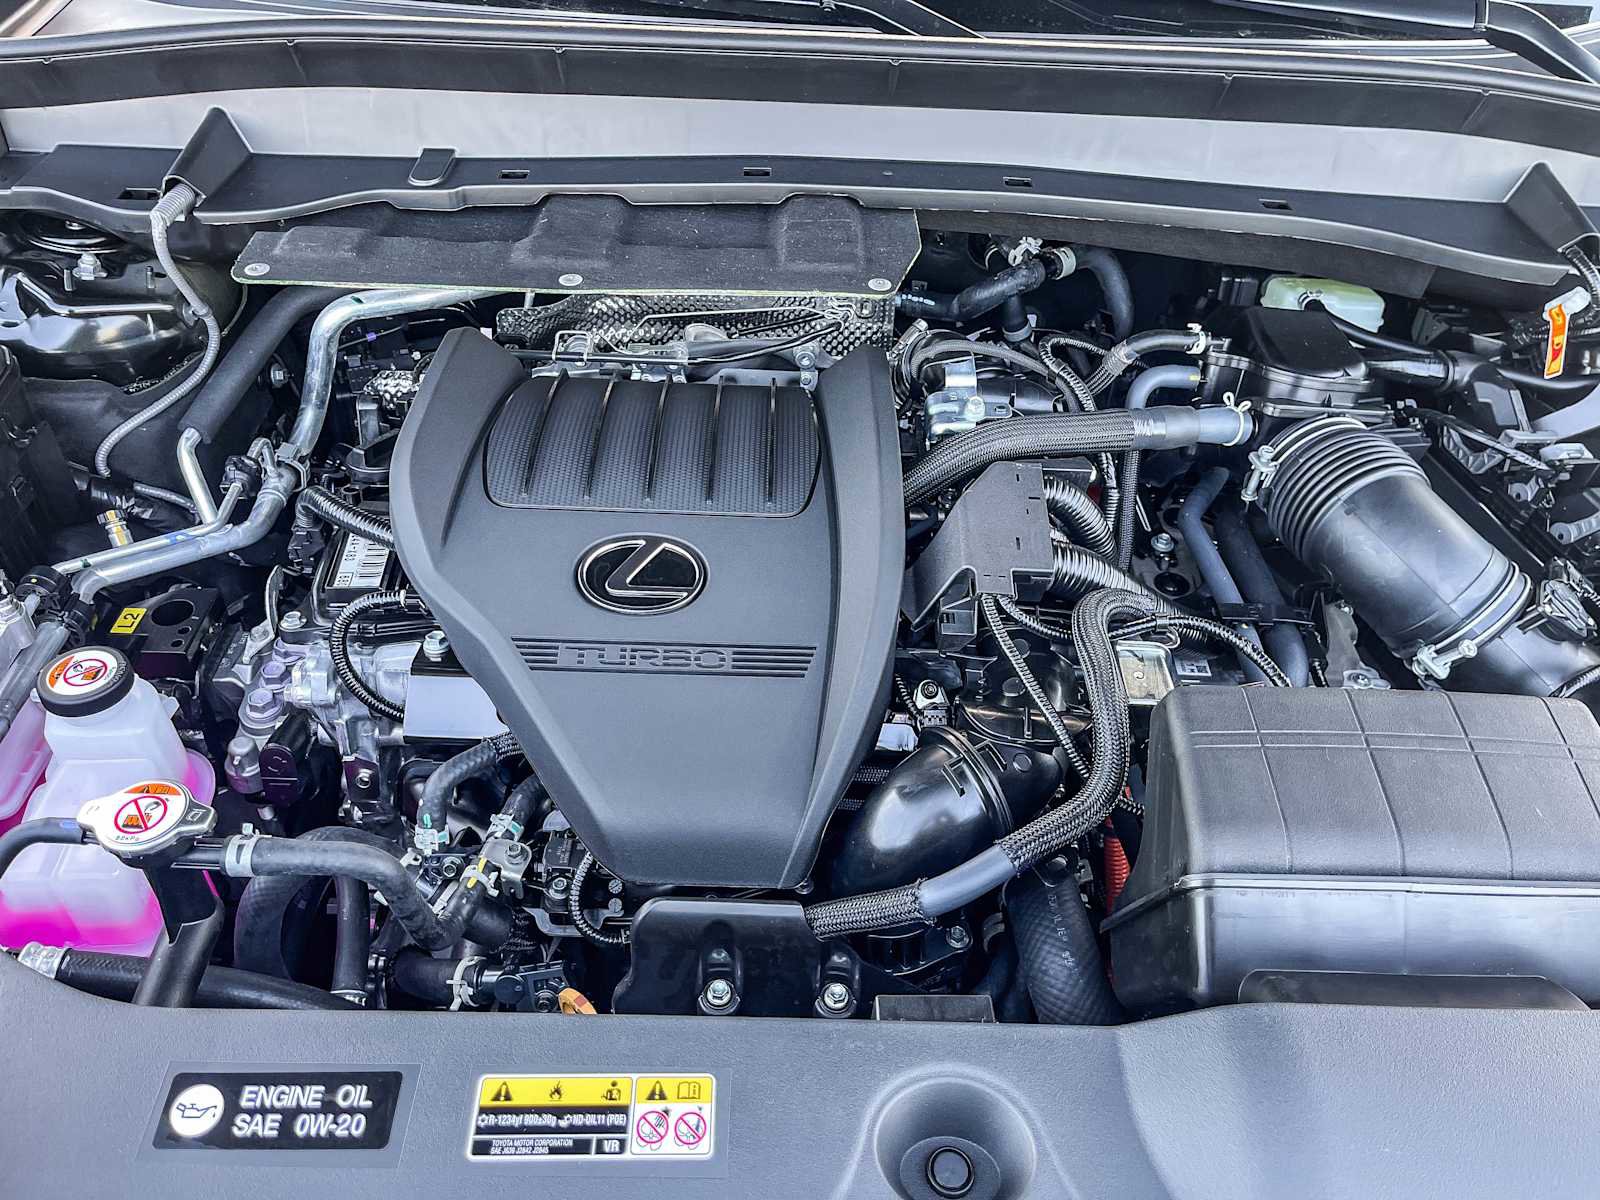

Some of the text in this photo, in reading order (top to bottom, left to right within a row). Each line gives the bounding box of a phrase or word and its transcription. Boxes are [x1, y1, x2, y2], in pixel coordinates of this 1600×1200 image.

[117, 613, 140, 627] L2
[564, 645, 727, 670] TURBO
[240, 1084, 373, 1108] ENGINE OIL
[232, 1113, 367, 1137] SAE 0W-20
[492, 1139, 574, 1147] TOYOTA MOTOR CORPORATION
[603, 1140, 620, 1153] VR
